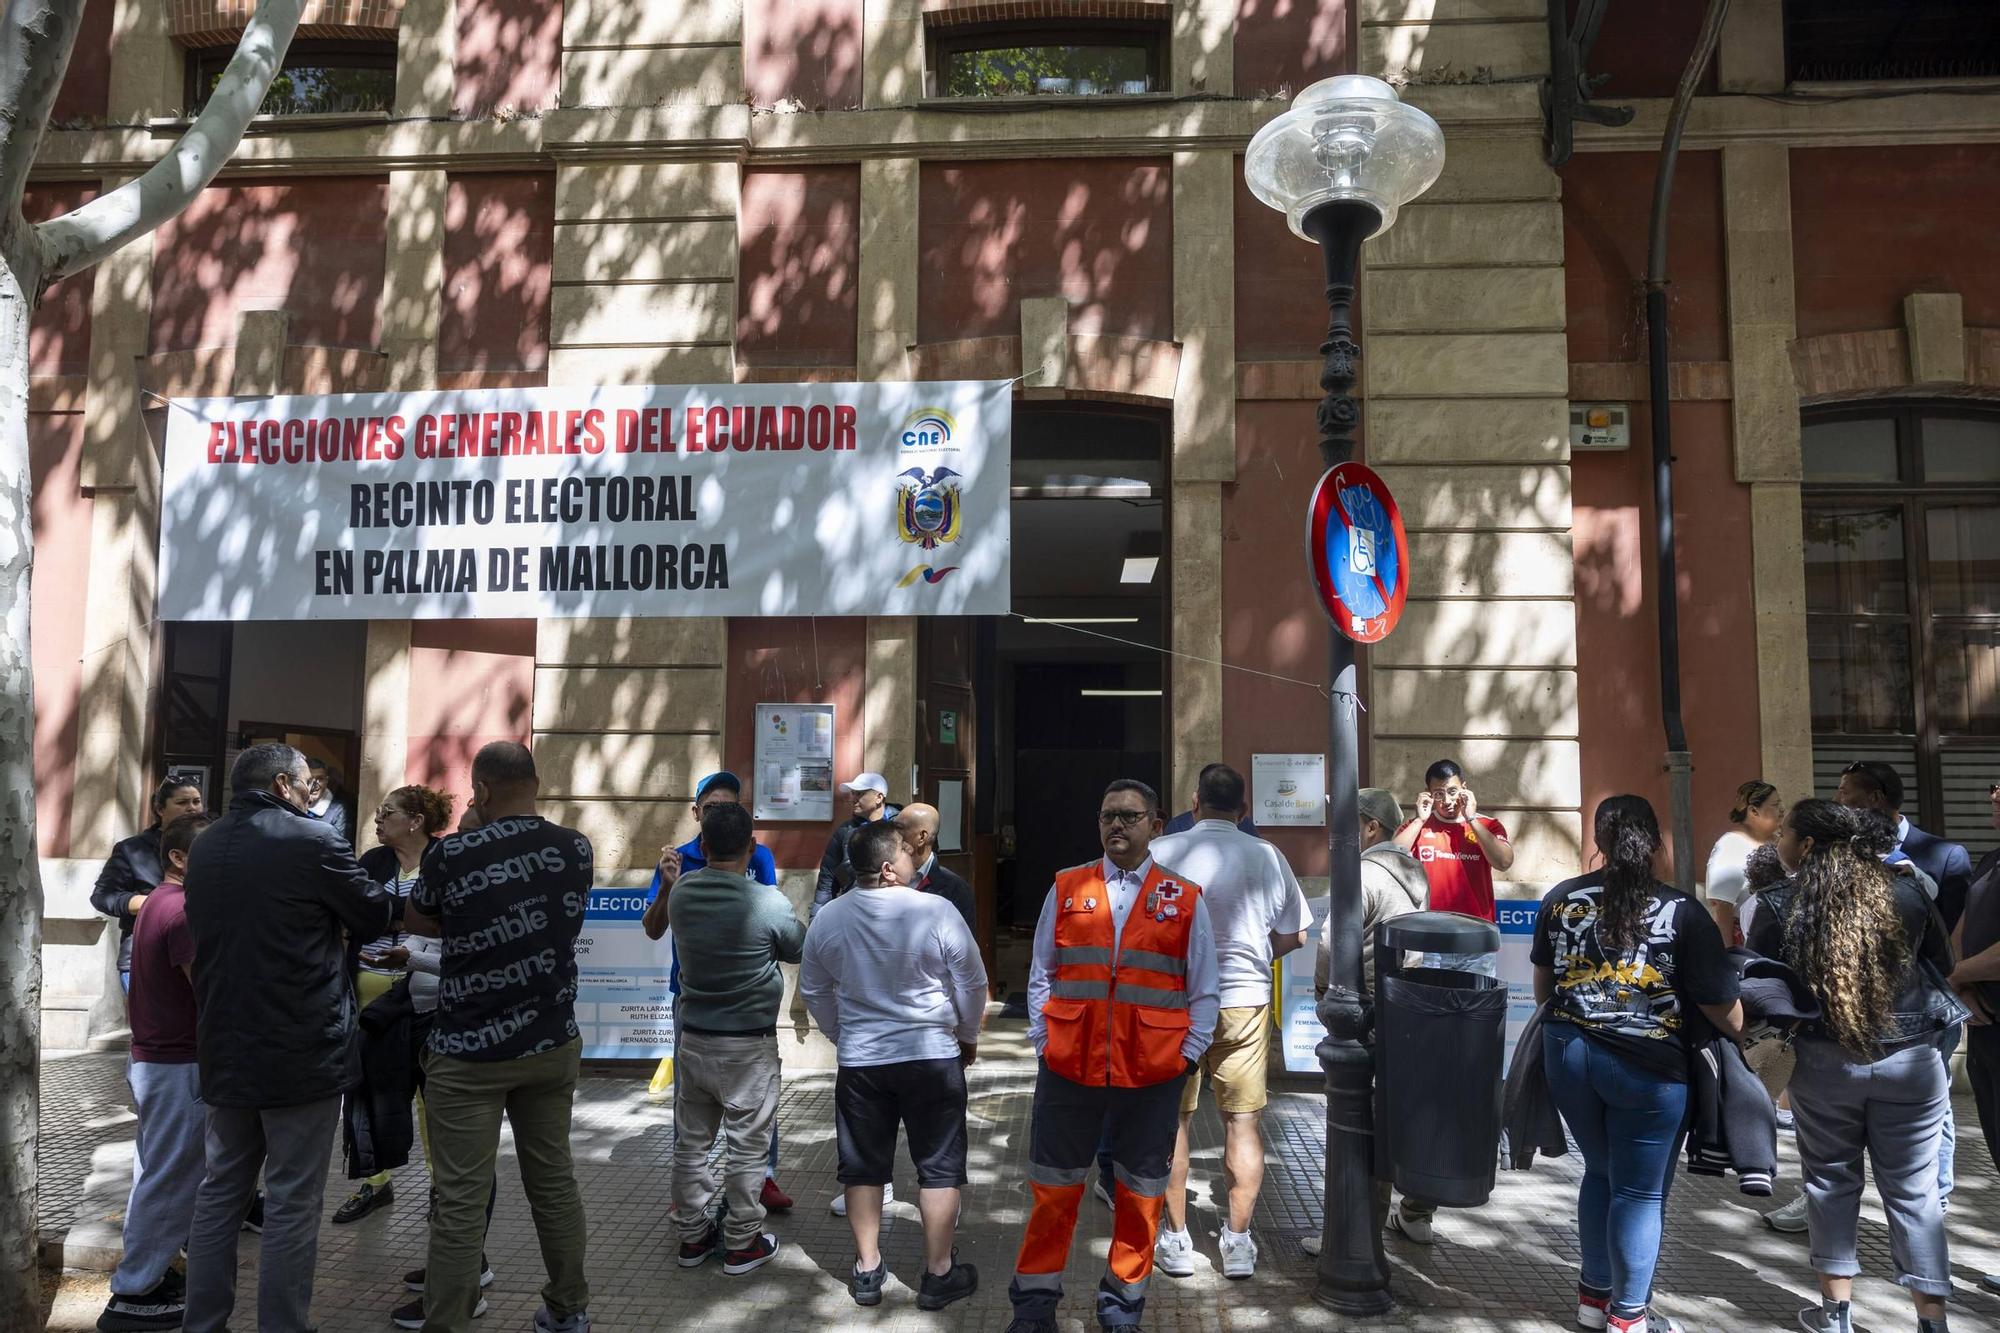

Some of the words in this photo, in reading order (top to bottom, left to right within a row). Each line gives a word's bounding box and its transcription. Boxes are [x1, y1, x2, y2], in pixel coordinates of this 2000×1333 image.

[206, 416, 405, 465] ELECCIONES
[413, 408, 606, 459] GENERALES
[615, 406, 677, 453] DEL
[685, 403, 857, 453] ECUADOR
[349, 480, 495, 528] RECINTO
[504, 475, 697, 524] ELECTORAL
[315, 550, 354, 596] EN
[363, 548, 478, 595] PALMA
[487, 547, 529, 592] DE
[538, 543, 729, 592] MALLORCA
[574, 938, 594, 946] RRIO
[441, 947, 557, 1006] Subscrib
[646, 1005, 673, 1013] LARAM
